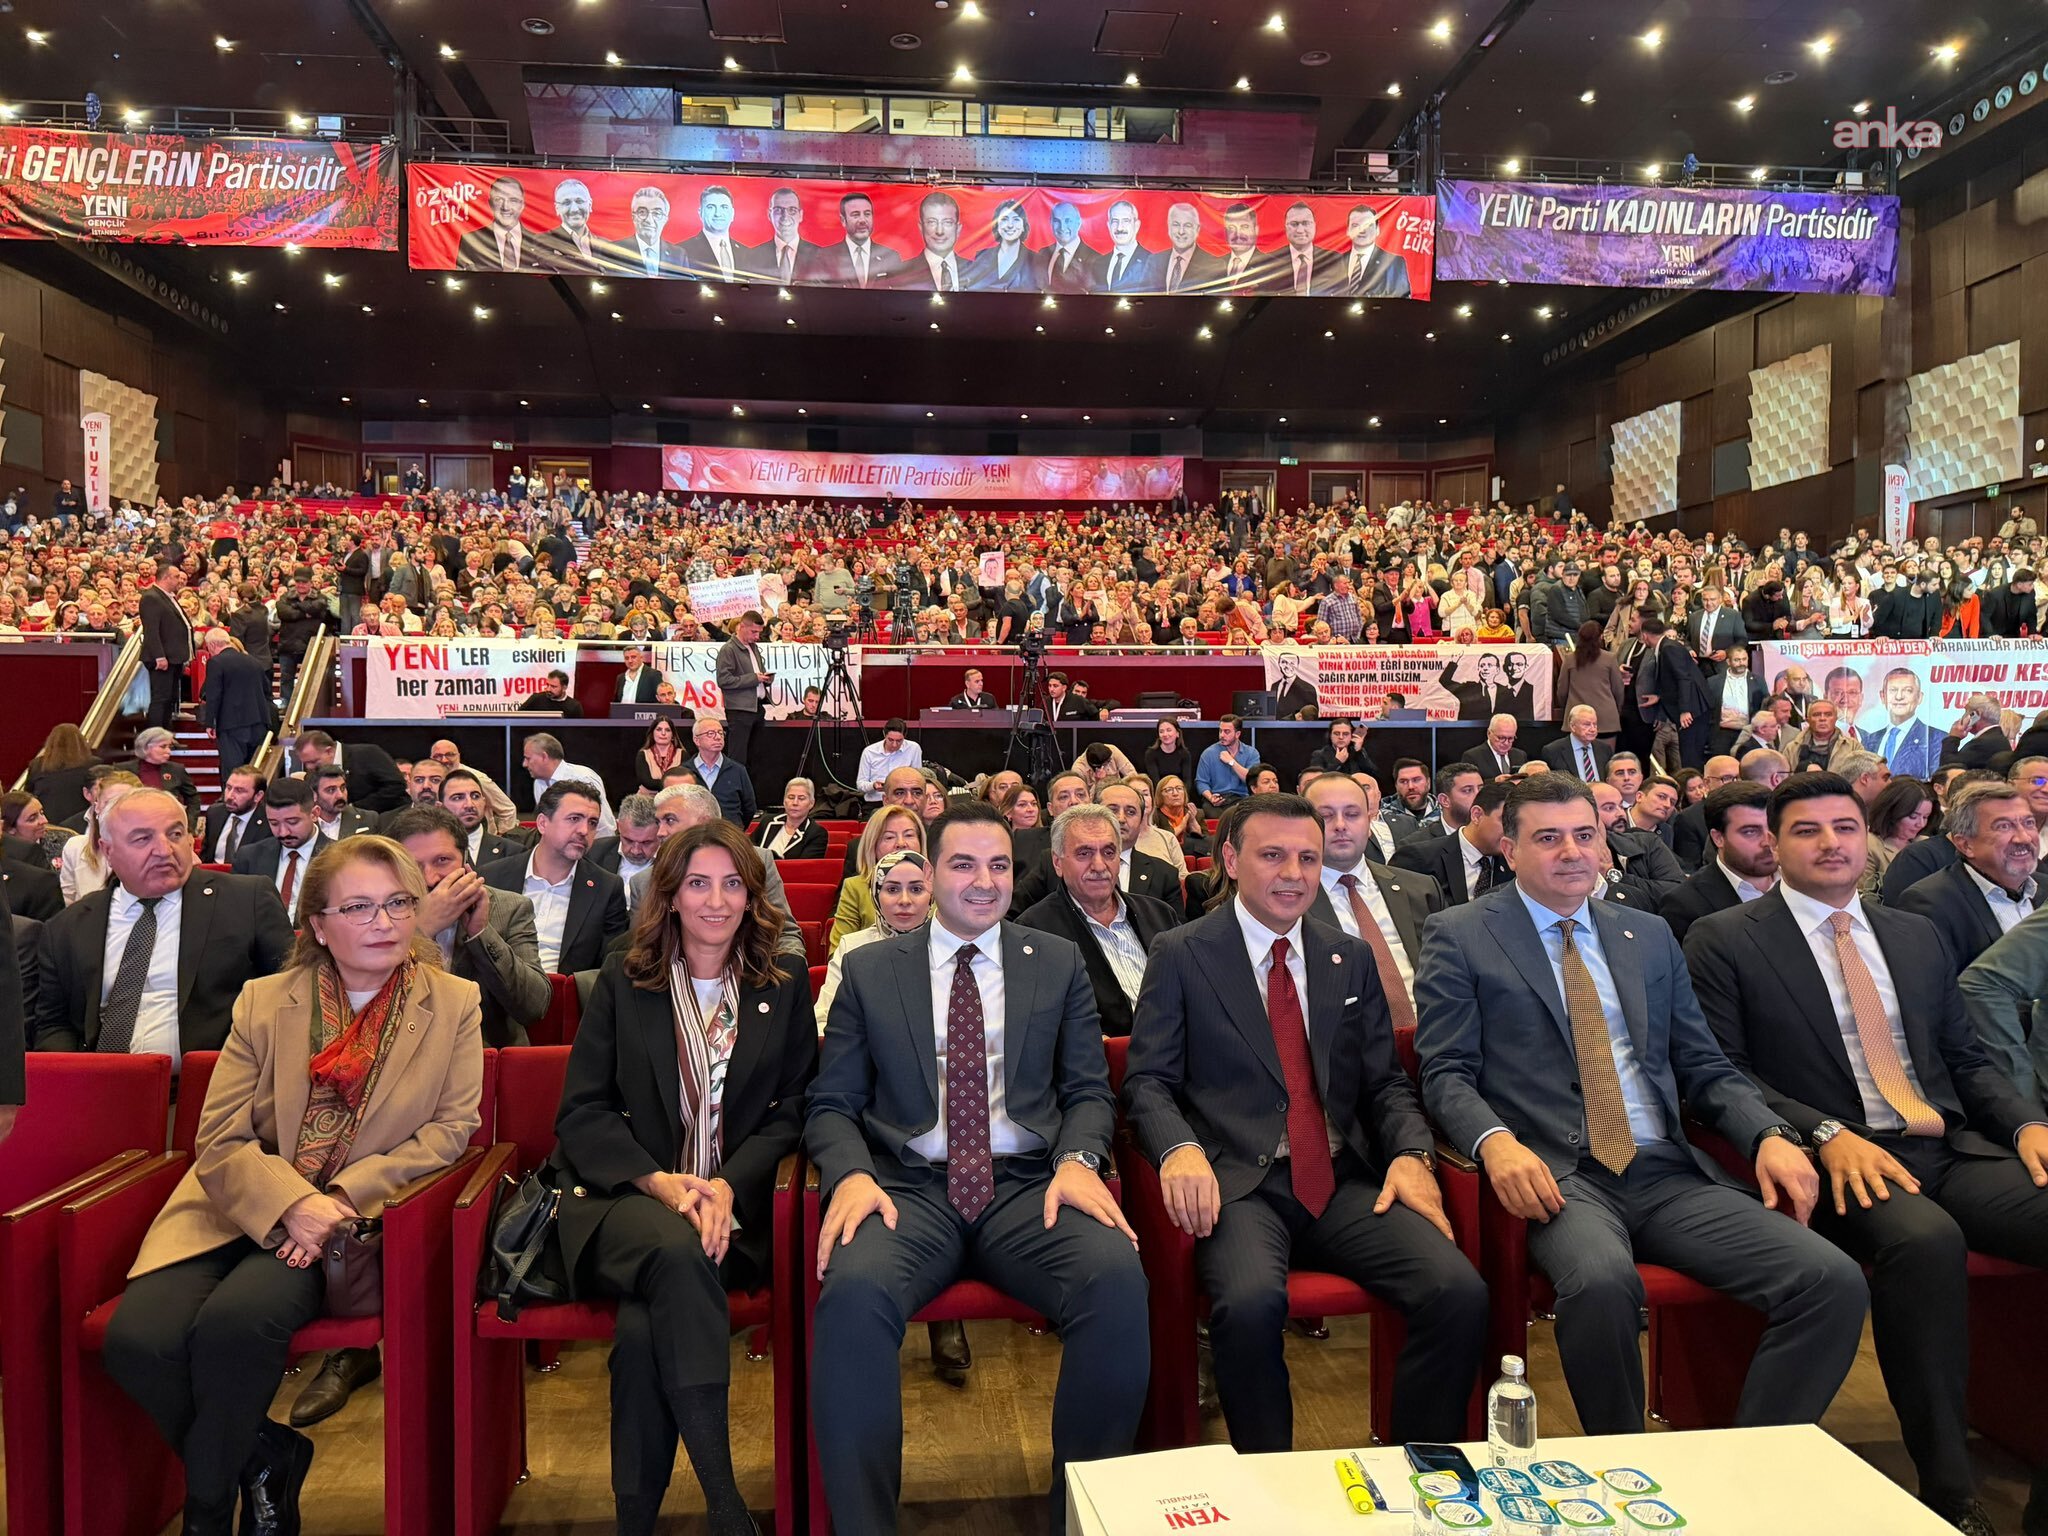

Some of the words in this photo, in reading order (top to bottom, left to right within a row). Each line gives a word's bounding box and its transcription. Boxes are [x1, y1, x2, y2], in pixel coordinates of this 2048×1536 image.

[206, 153, 346, 191] Partisidir
[1537, 197, 1601, 232] Parti
[1603, 199, 1762, 236] KADINLARIN
[1766, 204, 1878, 240] Partisidir
[786, 462, 827, 483] Parti
[904, 466, 977, 487] Partisidir
[512, 648, 566, 663] eskileri
[1802, 643, 1826, 658] IŞIK
[1827, 642, 1873, 656] PARLAR
[1932, 640, 2011, 653] KARANLIKLAR
[655, 645, 695, 673] HER
[1319, 661, 1344, 671] KIRIK
[1380, 659, 1401, 670] EĞRİ
[1318, 672, 1346, 683] SAĞIR
[1347, 672, 1379, 683] KAPIM,
[1930, 664, 2008, 683] UMUDU
[397, 677, 429, 697] her
[434, 677, 497, 697] zaman
[682, 679, 725, 710] AS
[1319, 683, 1360, 694] VAKTİDİR
[1363, 696, 1383, 706] ŞİM
[1434, 709, 1456, 719] KOLU
